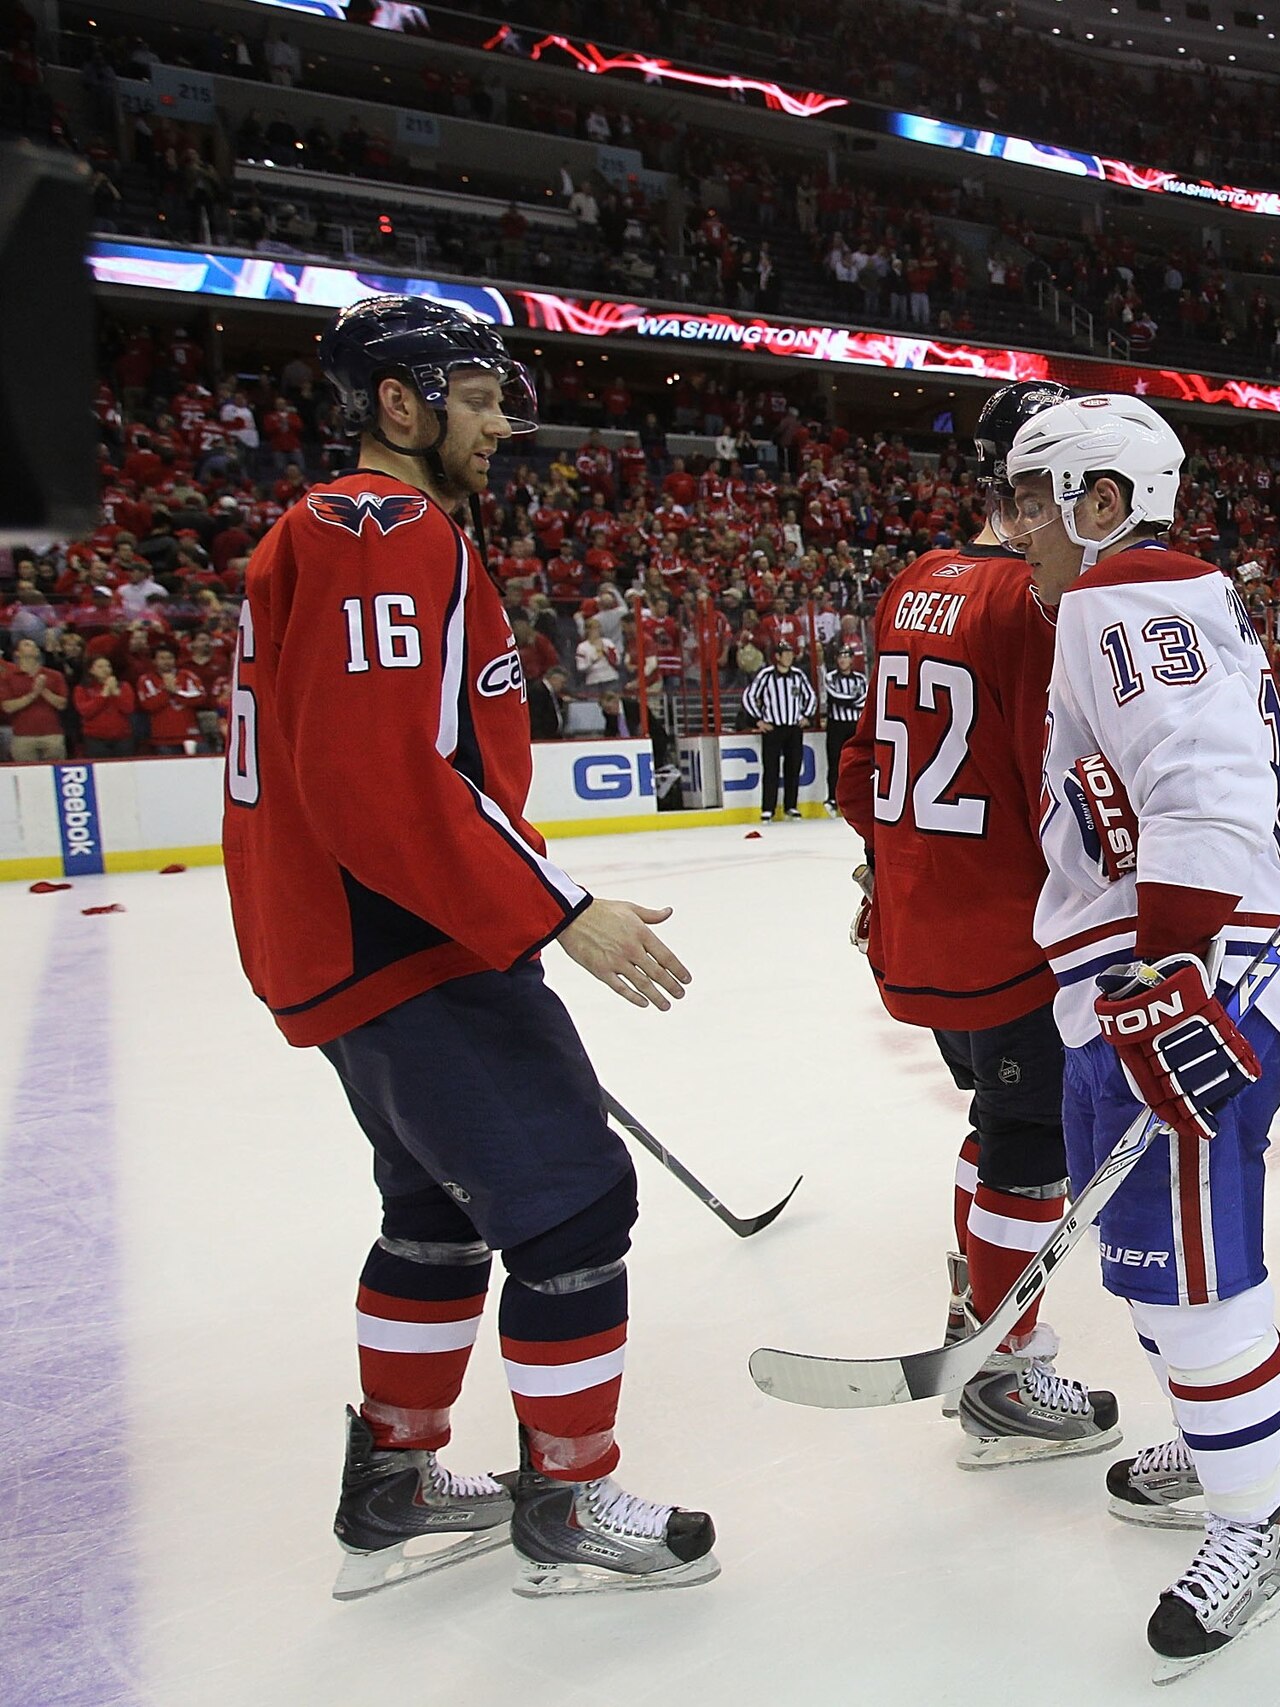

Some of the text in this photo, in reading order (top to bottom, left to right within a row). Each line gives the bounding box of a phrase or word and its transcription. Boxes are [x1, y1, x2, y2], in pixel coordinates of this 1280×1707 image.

[178, 84, 211, 104] 215
[1163, 180, 1258, 207] WASHINGTON
[636, 316, 816, 349] WASHINGTON
[342, 593, 423, 674] 16
[894, 590, 966, 638] GREEN
[1100, 614, 1209, 707] 13
[874, 650, 991, 837] 52
[60, 766, 94, 857] Reebok
[1080, 753, 1138, 876] ASTON
[1081, 803, 1095, 830] CAMMY
[1016, 1217, 1078, 1312] SE 16
[1031, 1409, 1063, 1422] BAUER
